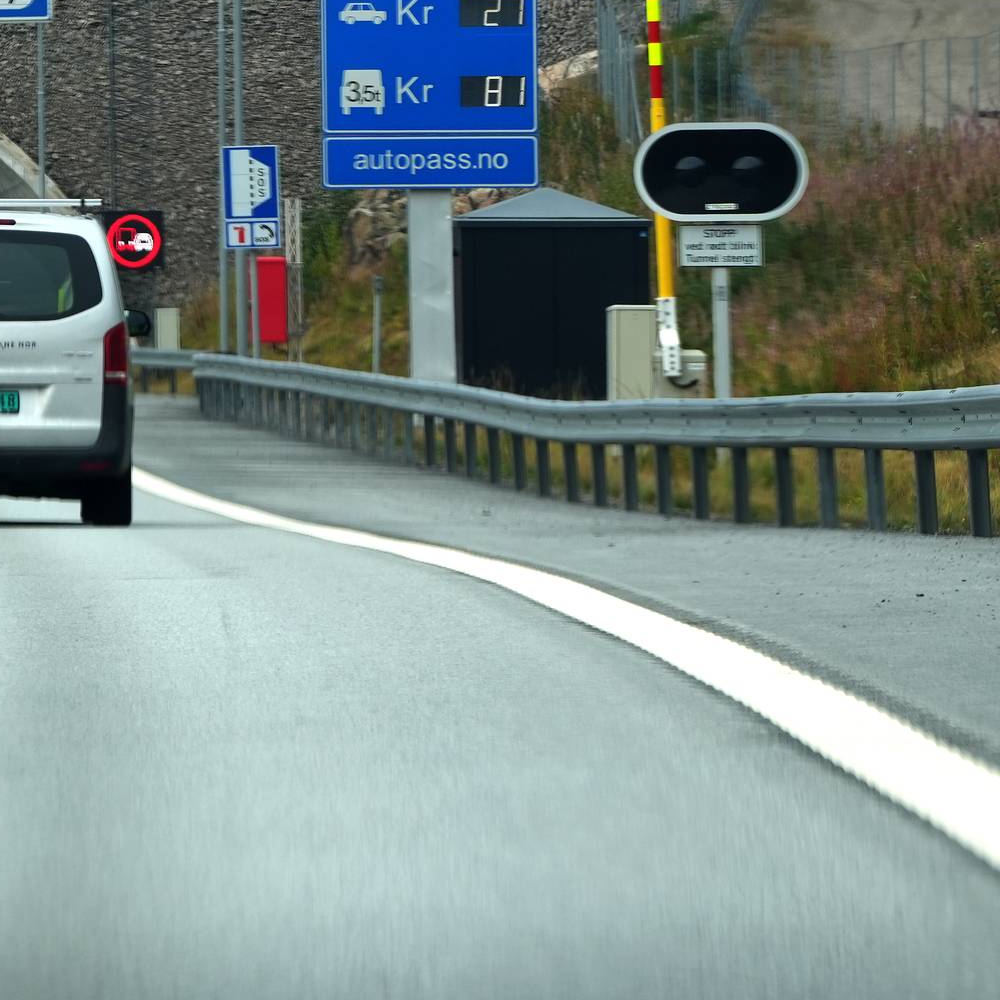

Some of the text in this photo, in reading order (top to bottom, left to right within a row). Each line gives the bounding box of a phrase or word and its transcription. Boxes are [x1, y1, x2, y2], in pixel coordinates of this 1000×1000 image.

[395, 76, 434, 105] Kr
[484, 76, 526, 107] 81
[353, 150, 509, 174] autopass.no
